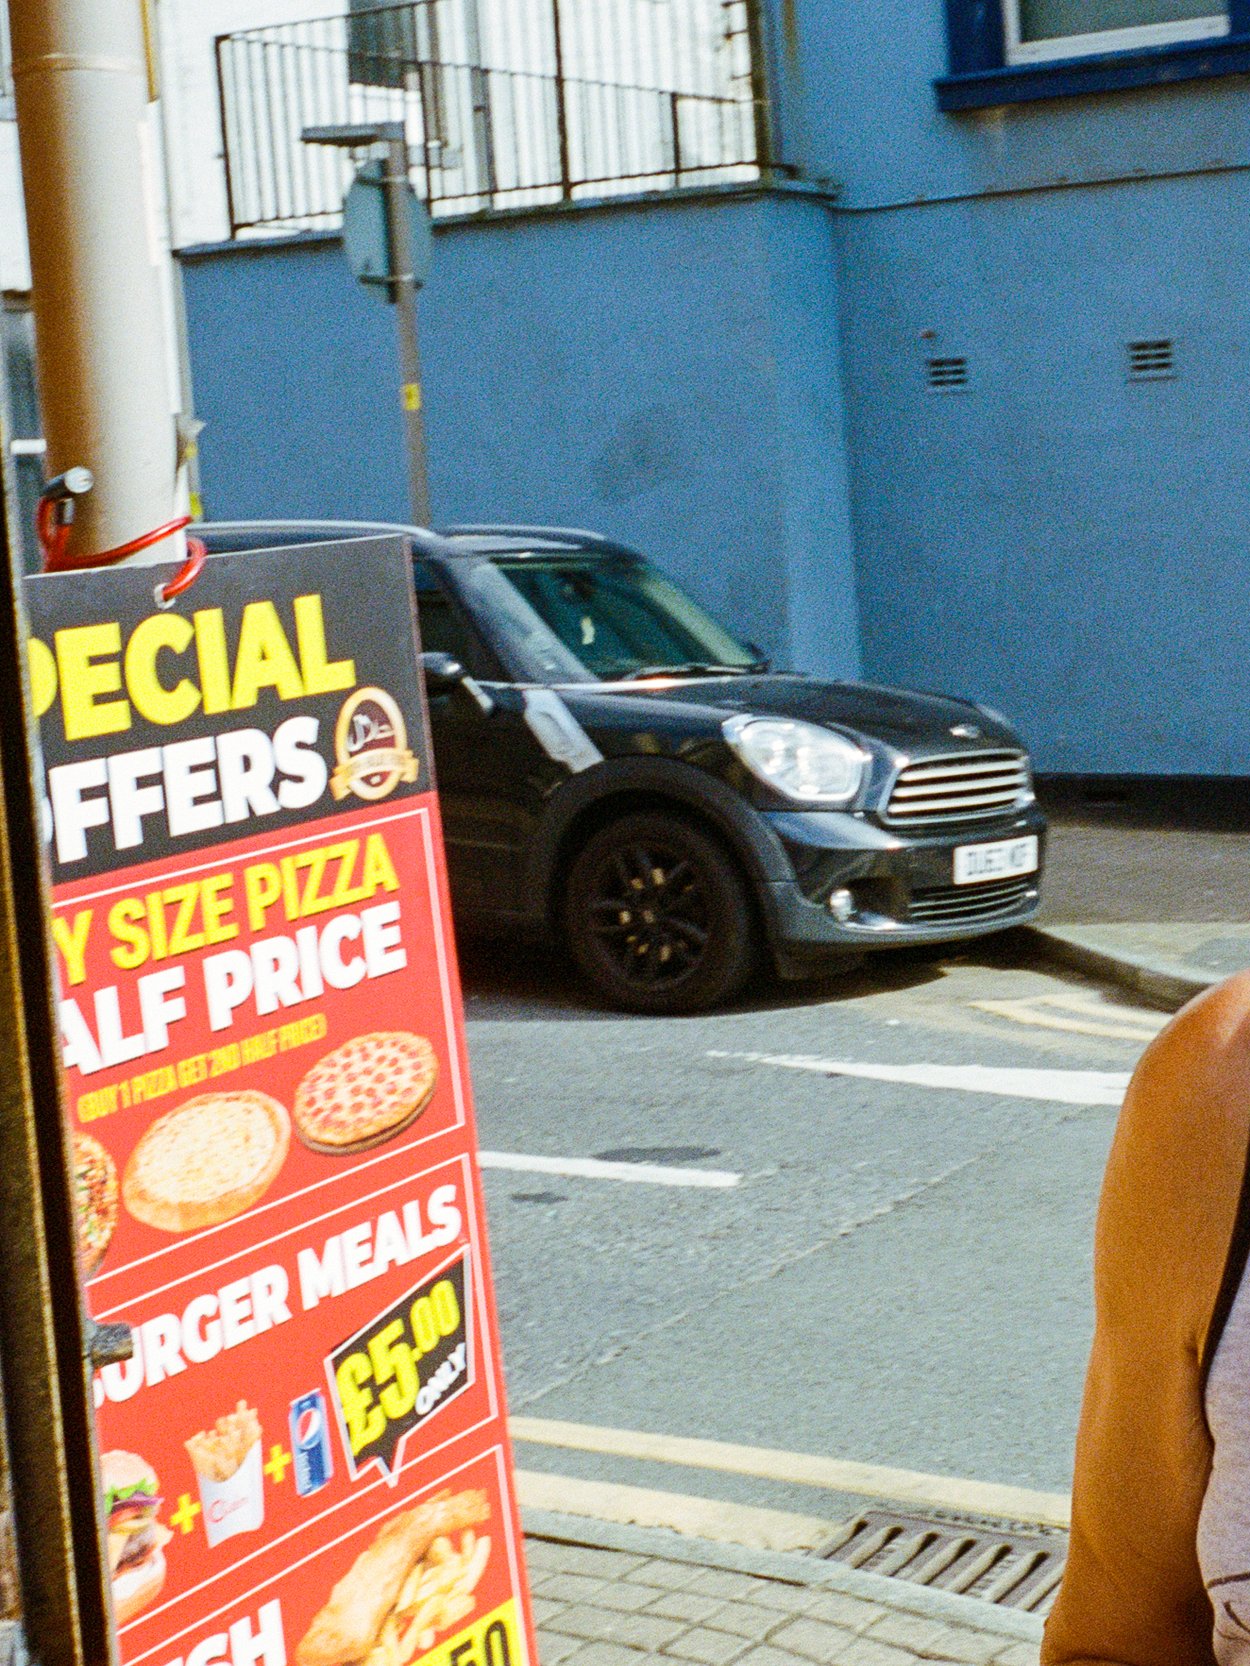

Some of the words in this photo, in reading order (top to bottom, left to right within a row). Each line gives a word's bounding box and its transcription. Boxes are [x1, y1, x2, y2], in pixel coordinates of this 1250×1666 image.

[43, 716, 328, 864] FFERS
[107, 872, 241, 971] SIZE
[244, 832, 400, 932] PIZZA
[203, 900, 407, 1032] PRICE
[92, 1264, 293, 1408] URGER
[297, 1185, 462, 1310] MEALS
[336, 1280, 460, 1457] £5.00
[415, 1342, 467, 1416] ONLY
